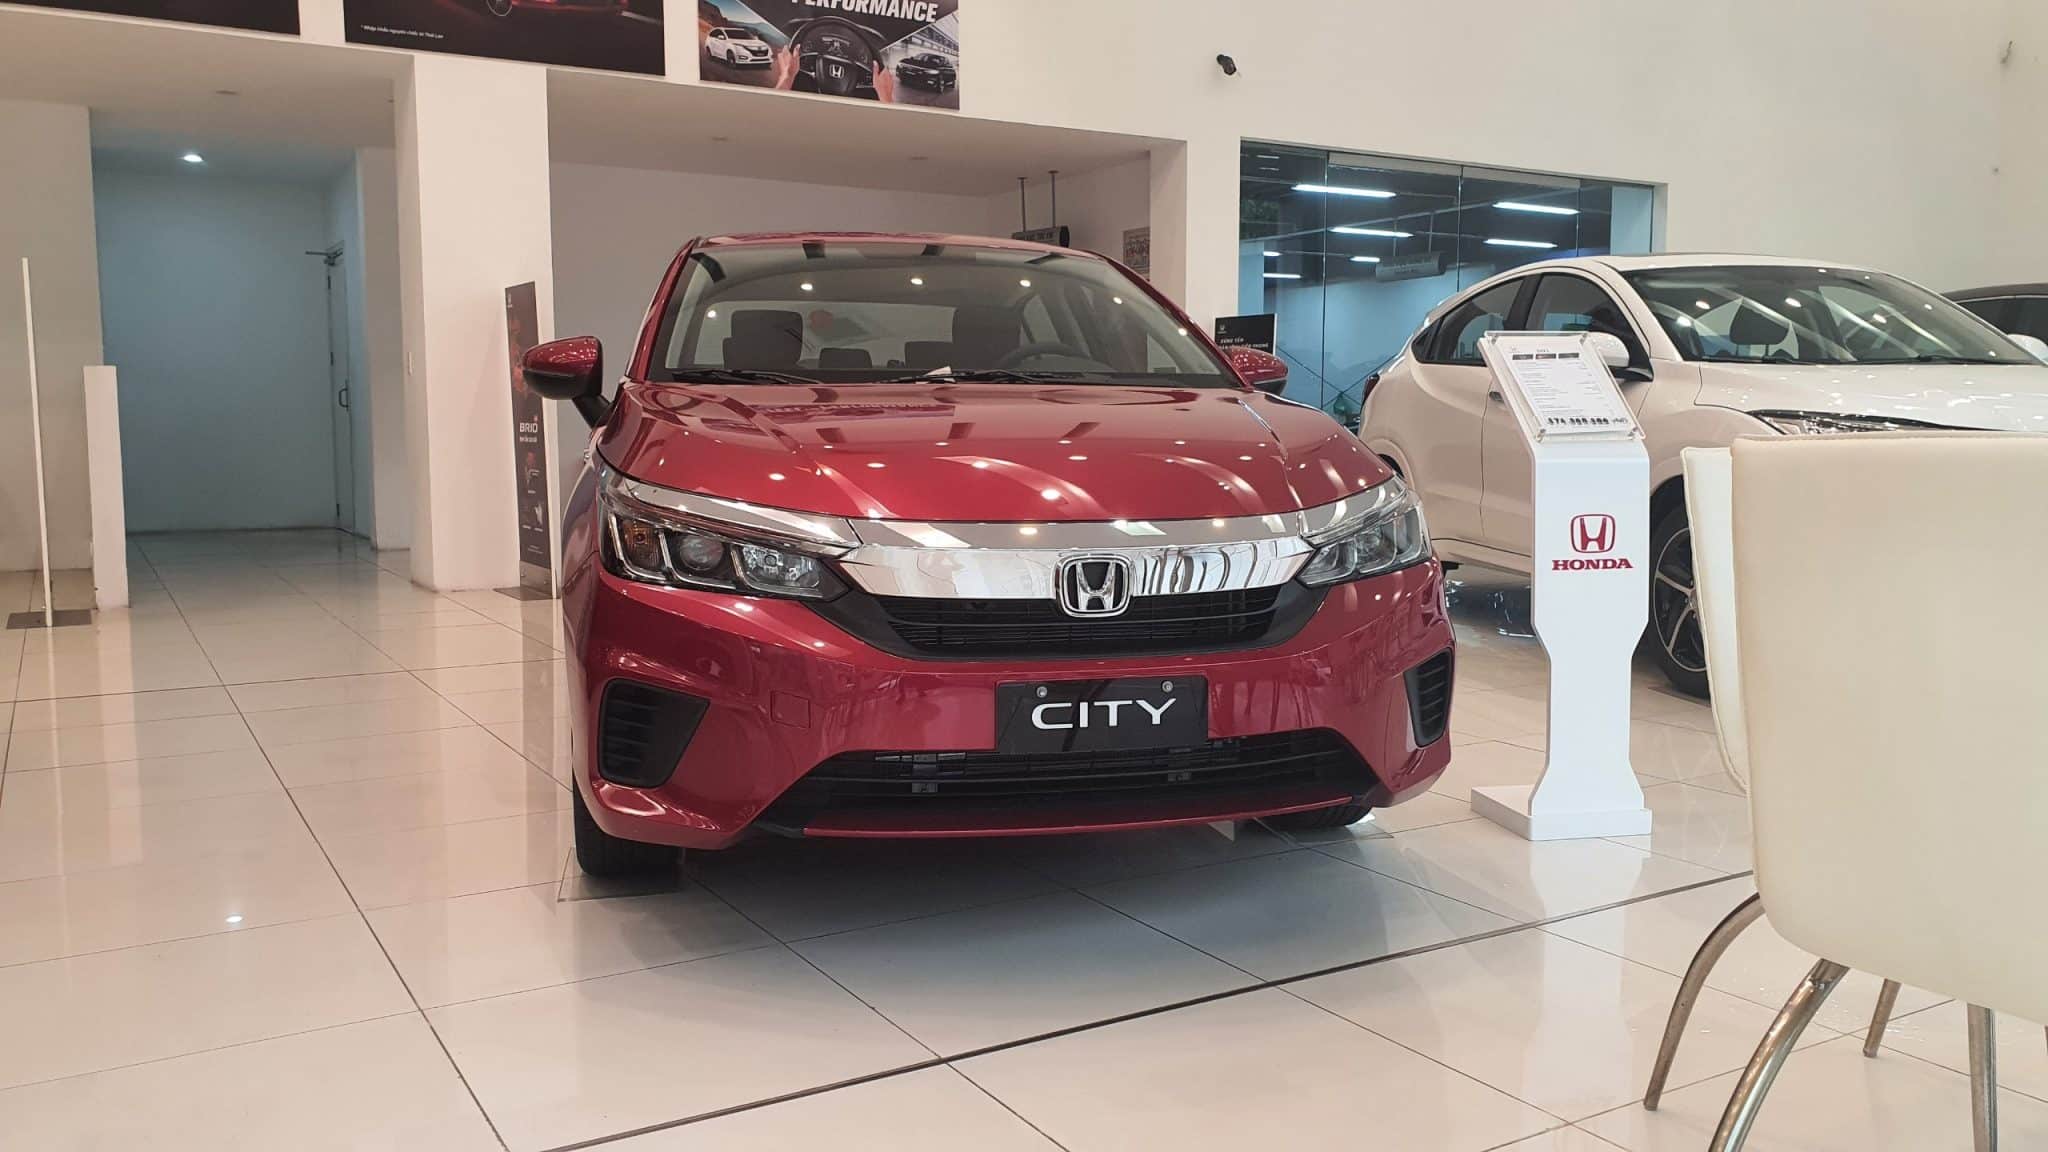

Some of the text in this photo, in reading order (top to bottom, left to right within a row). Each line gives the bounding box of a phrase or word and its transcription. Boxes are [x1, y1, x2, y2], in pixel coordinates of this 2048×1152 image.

[791, 0, 938, 23] ORMANCE
[519, 422, 538, 433] BRIO
[1552, 558, 1634, 571] HONDA
[1031, 697, 1177, 730] CITY
